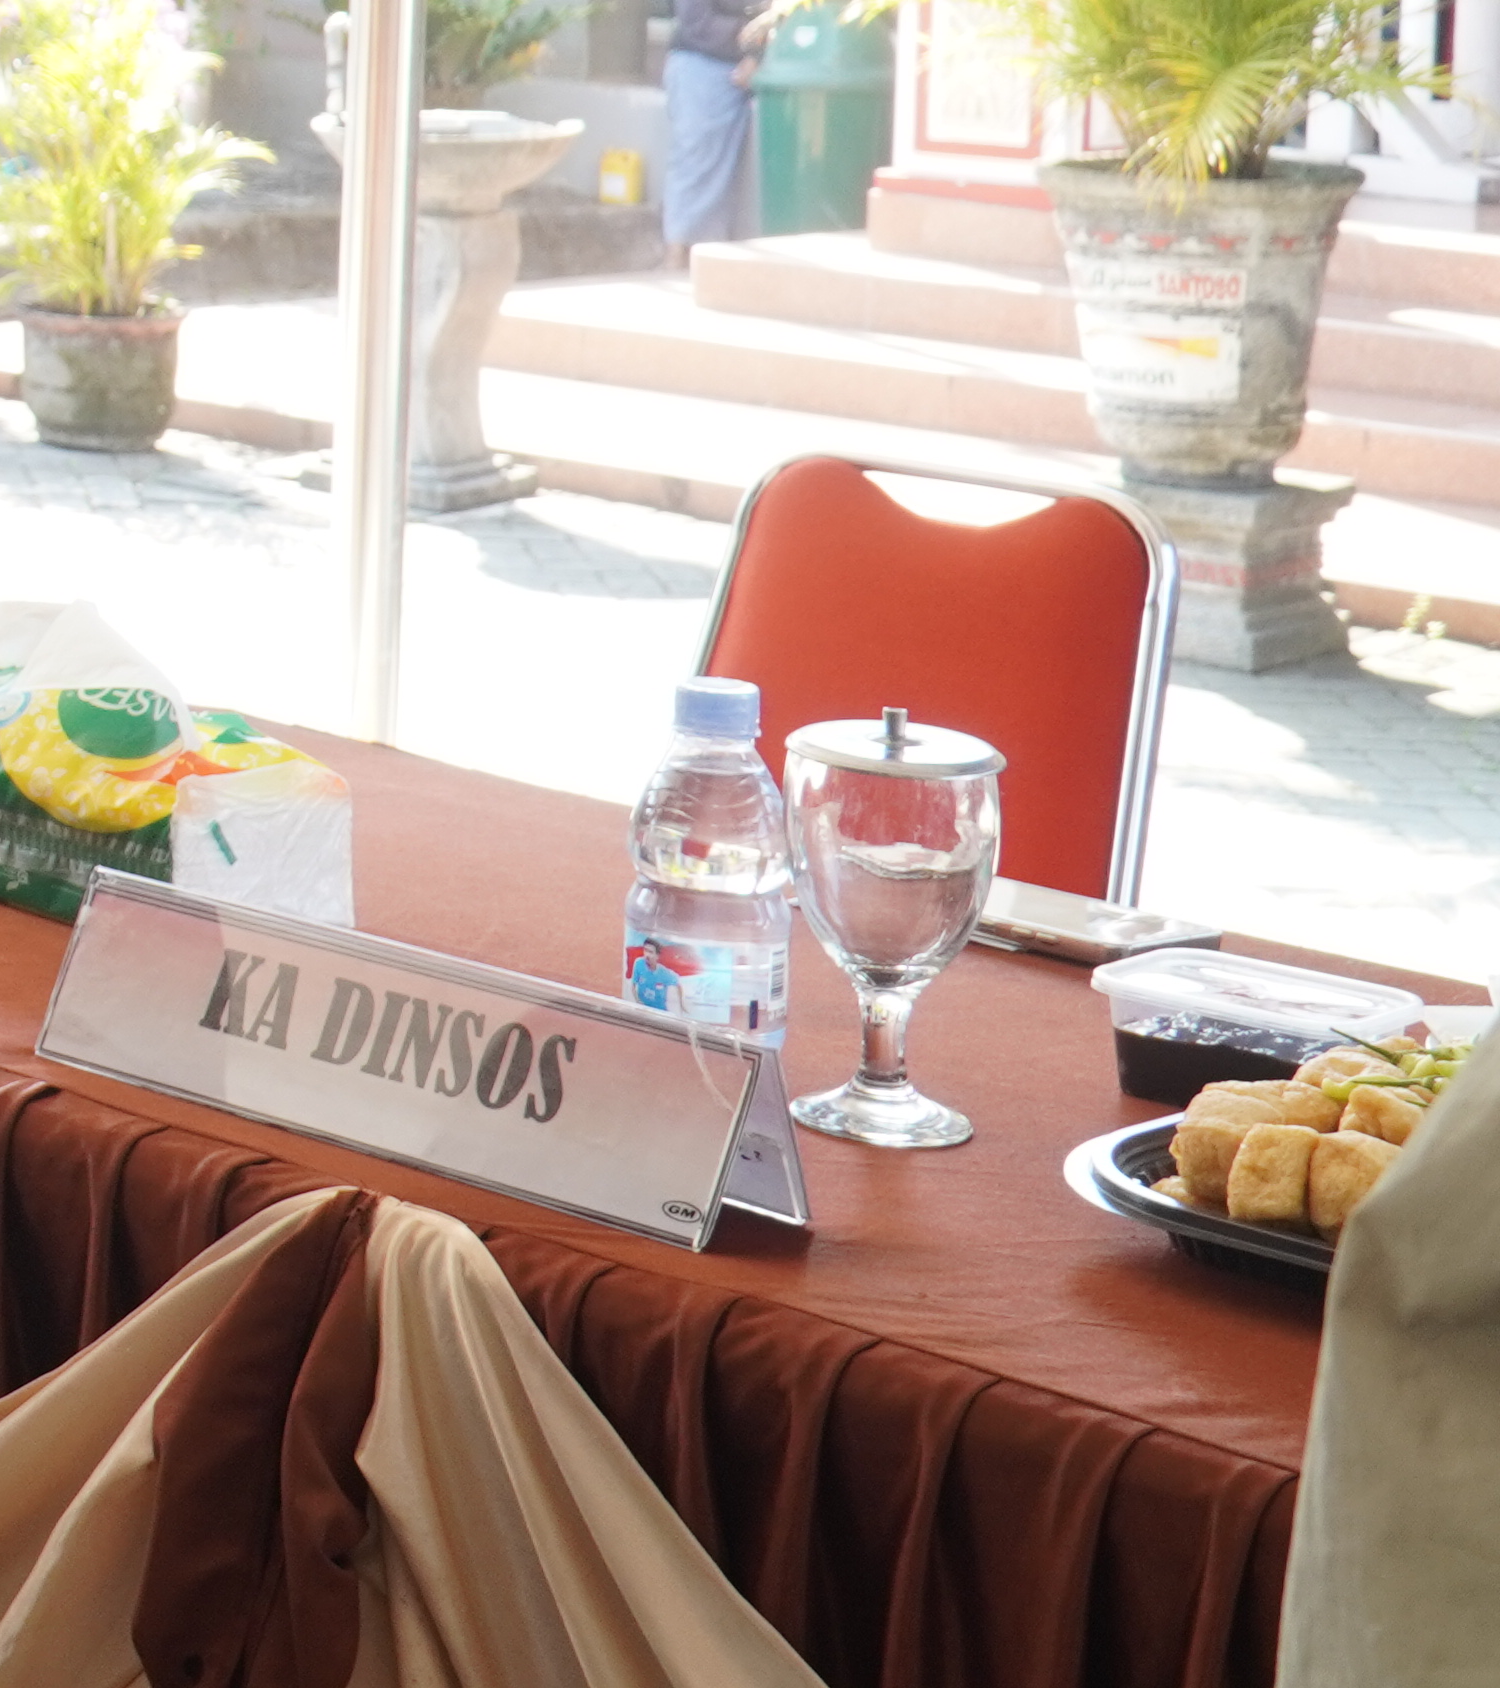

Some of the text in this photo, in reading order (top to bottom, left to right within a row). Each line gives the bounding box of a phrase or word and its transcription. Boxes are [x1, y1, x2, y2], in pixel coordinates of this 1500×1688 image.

[197, 948, 578, 1125] KA DINSOS
[667, 1204, 697, 1219] GM
